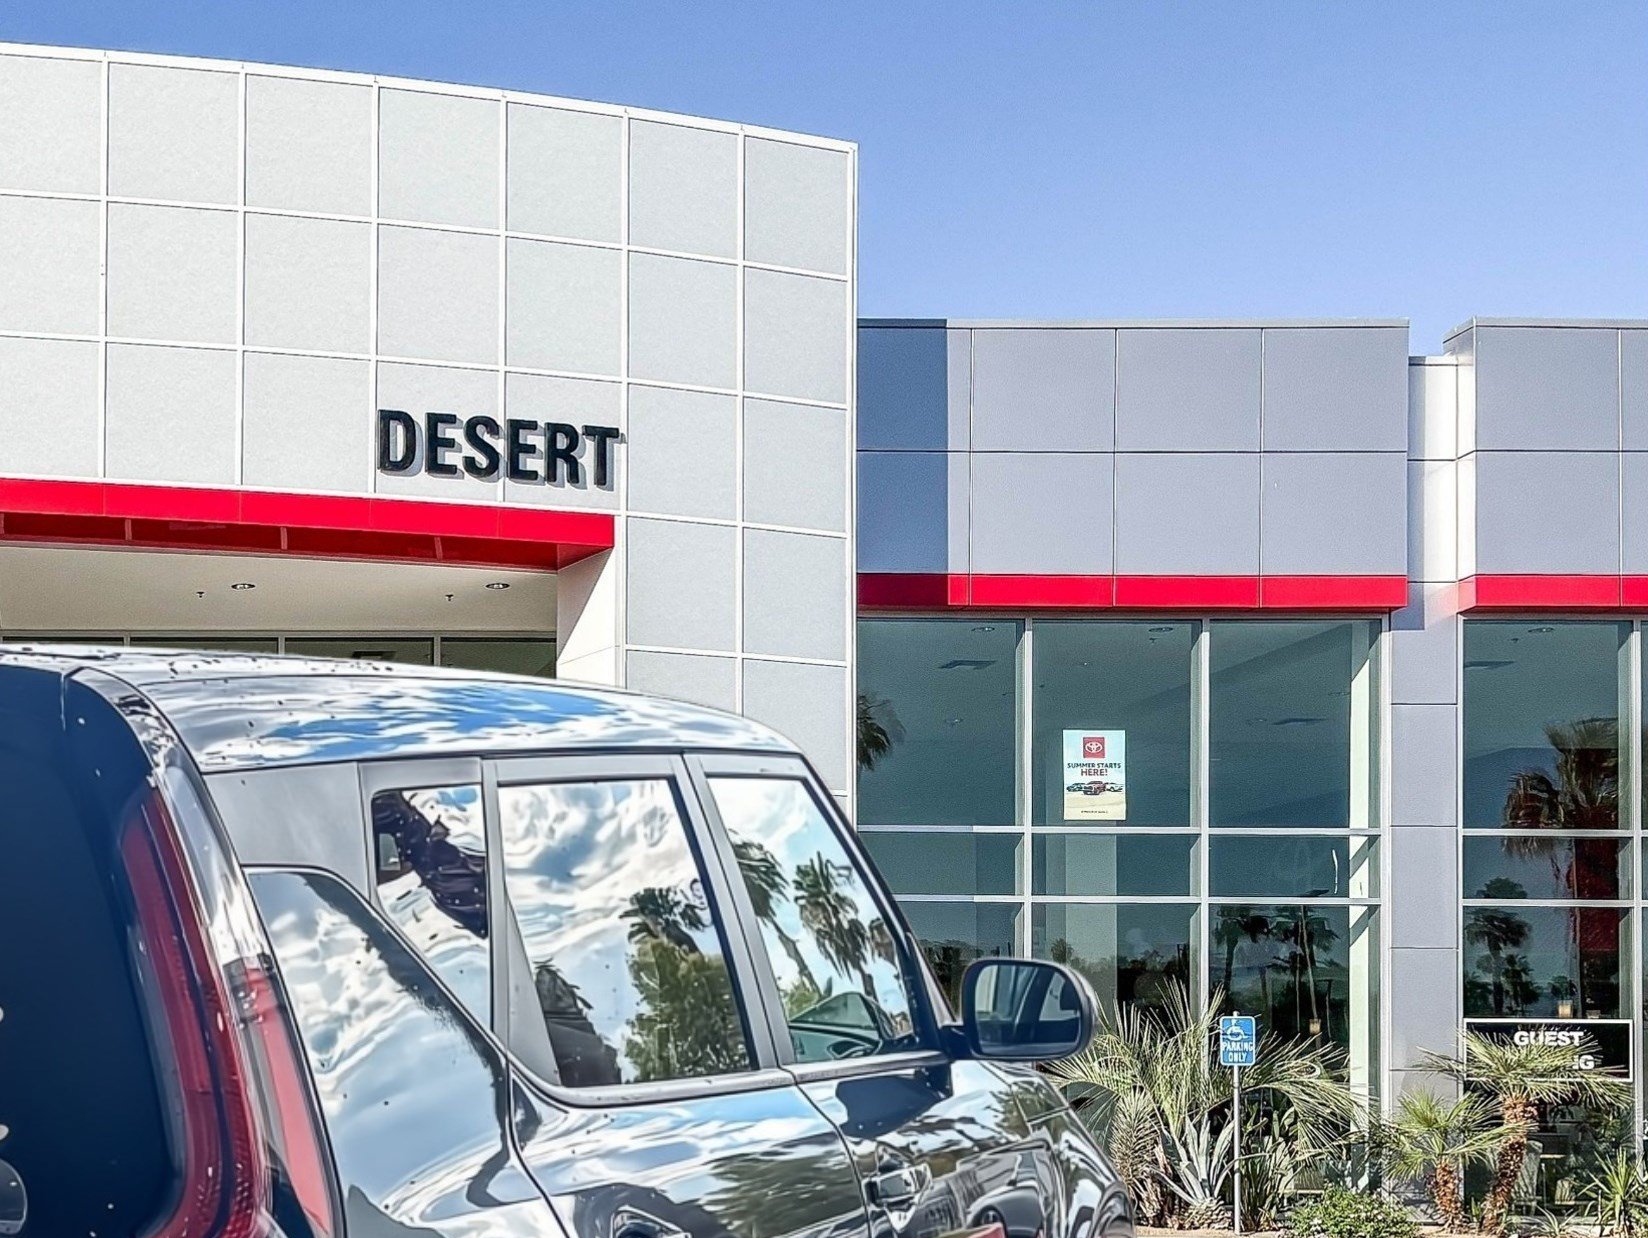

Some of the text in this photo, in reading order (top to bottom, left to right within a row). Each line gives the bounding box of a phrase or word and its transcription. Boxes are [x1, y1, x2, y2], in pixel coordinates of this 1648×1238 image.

[376, 409, 620, 486] DESERT
[1080, 768, 1108, 776] HERE!
[1513, 1031, 1584, 1046] GUEST
[1222, 1041, 1254, 1051] PARKING
[1228, 1051, 1248, 1062] ONLY
